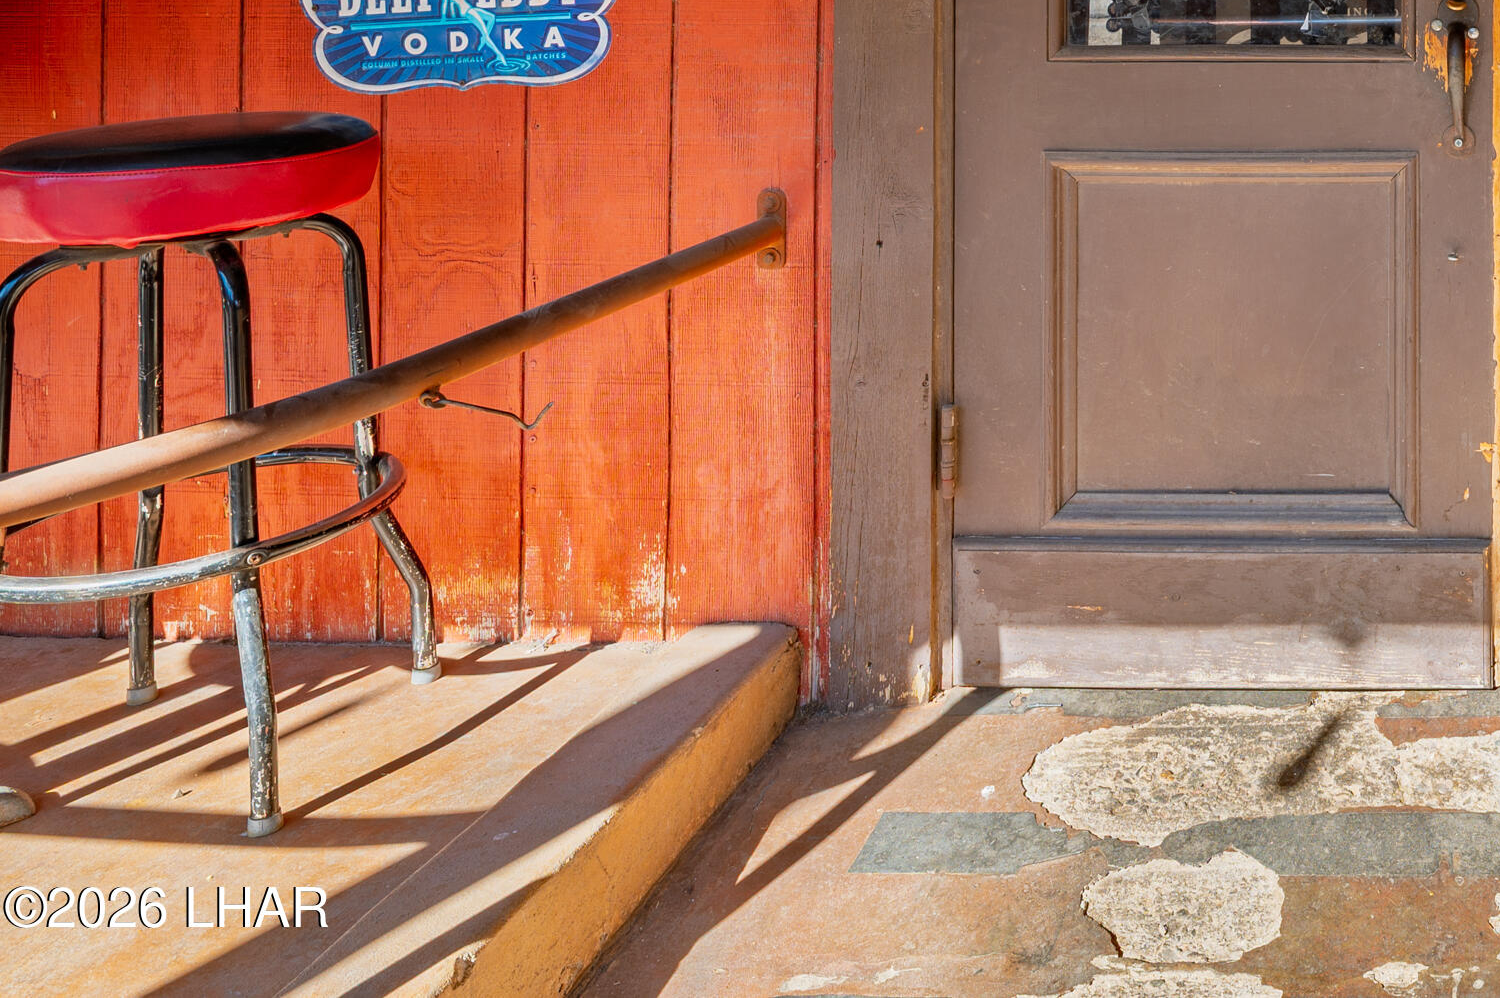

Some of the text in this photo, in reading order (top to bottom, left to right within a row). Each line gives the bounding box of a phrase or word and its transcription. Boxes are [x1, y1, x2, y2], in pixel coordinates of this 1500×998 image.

[361, 26, 566, 57] VODKA
[362, 58, 399, 70] COLUMN
[400, 57, 442, 67] DISTILLED
[456, 55, 485, 64] SMALL
[526, 52, 567, 61] BATCHES
